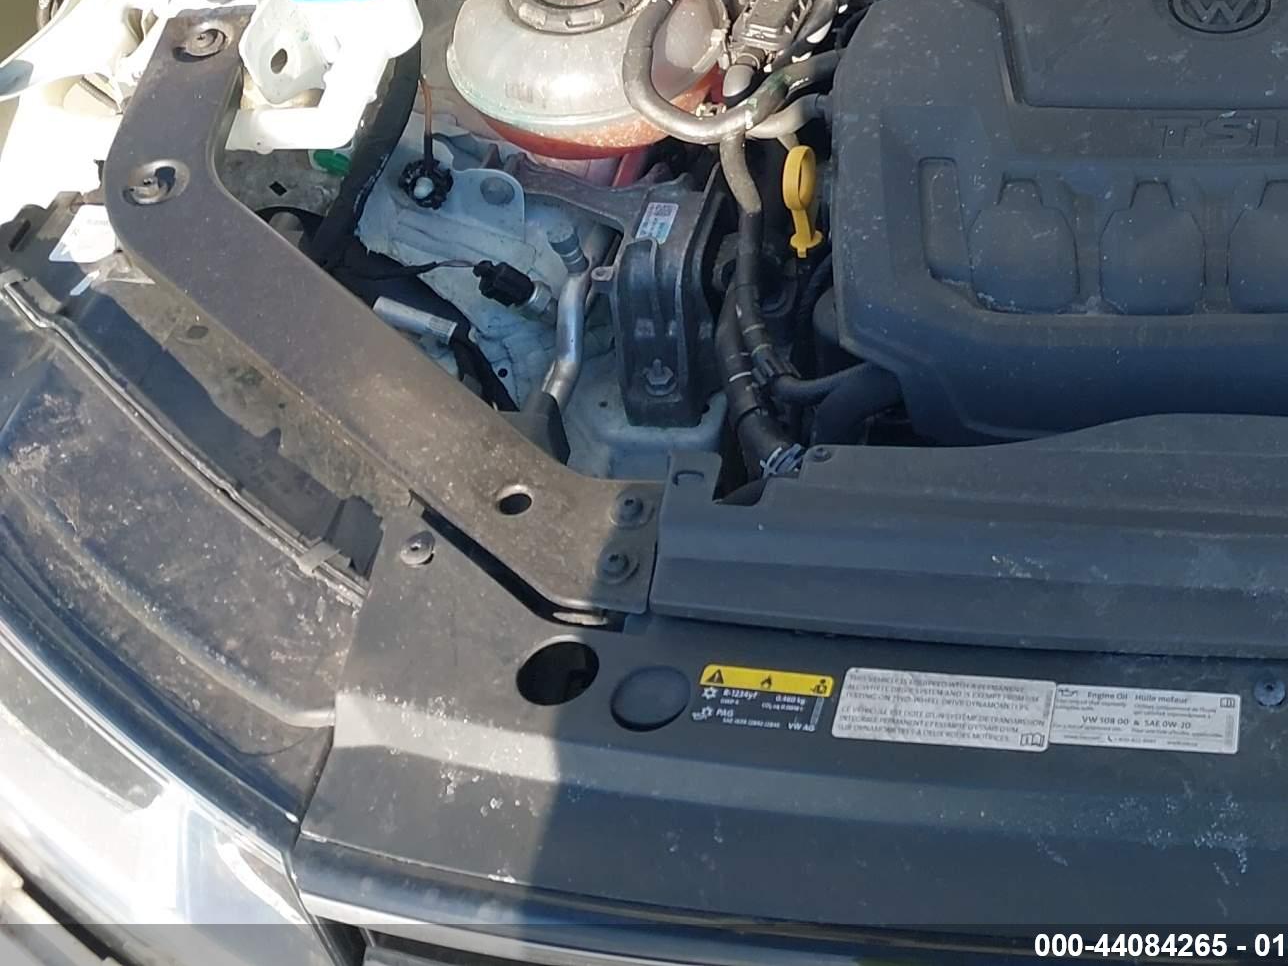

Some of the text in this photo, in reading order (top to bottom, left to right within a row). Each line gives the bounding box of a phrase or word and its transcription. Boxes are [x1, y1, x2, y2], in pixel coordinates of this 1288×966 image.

[1152, 115, 1280, 148] TSI
[722, 687, 758, 701] R-1234yf
[1087, 691, 1189, 704] Engine Oil Huile moteur
[715, 708, 734, 718] PAG
[1081, 715, 1098, 723] VW
[1117, 717, 1129, 725] 00
[1144, 719, 1160, 727] SAE
